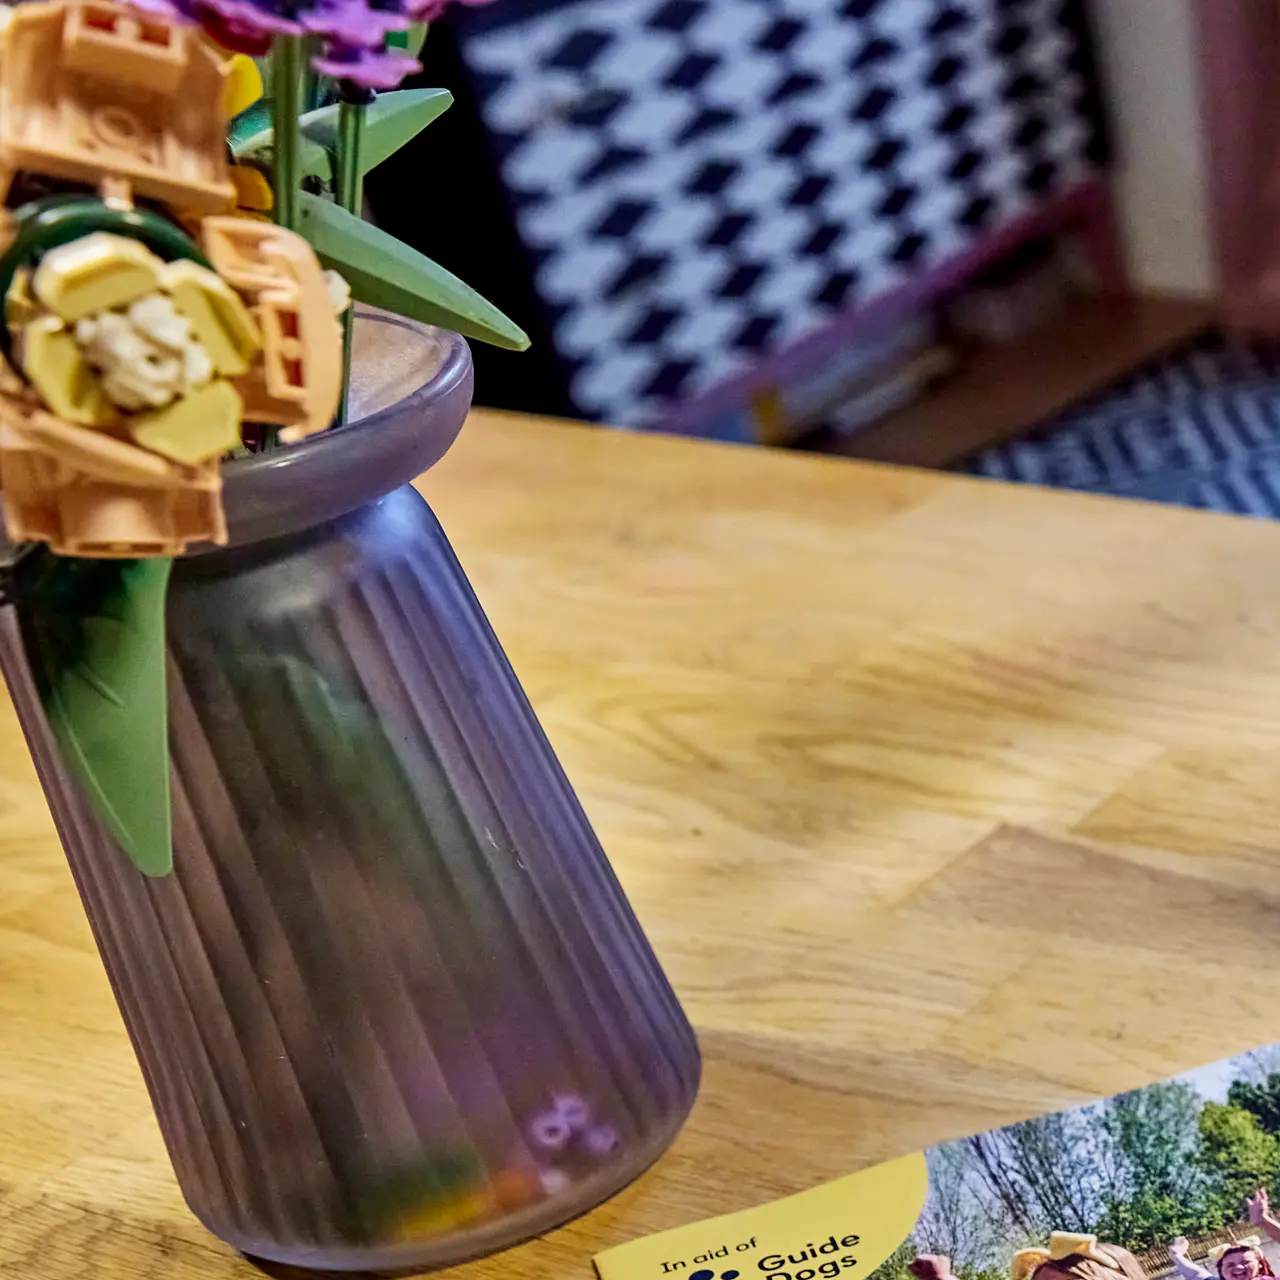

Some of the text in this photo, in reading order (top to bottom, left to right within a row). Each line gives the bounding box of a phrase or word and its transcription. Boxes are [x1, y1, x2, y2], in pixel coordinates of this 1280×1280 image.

[660, 1237, 757, 1274] In aid of
[758, 1234, 860, 1272] Guide
